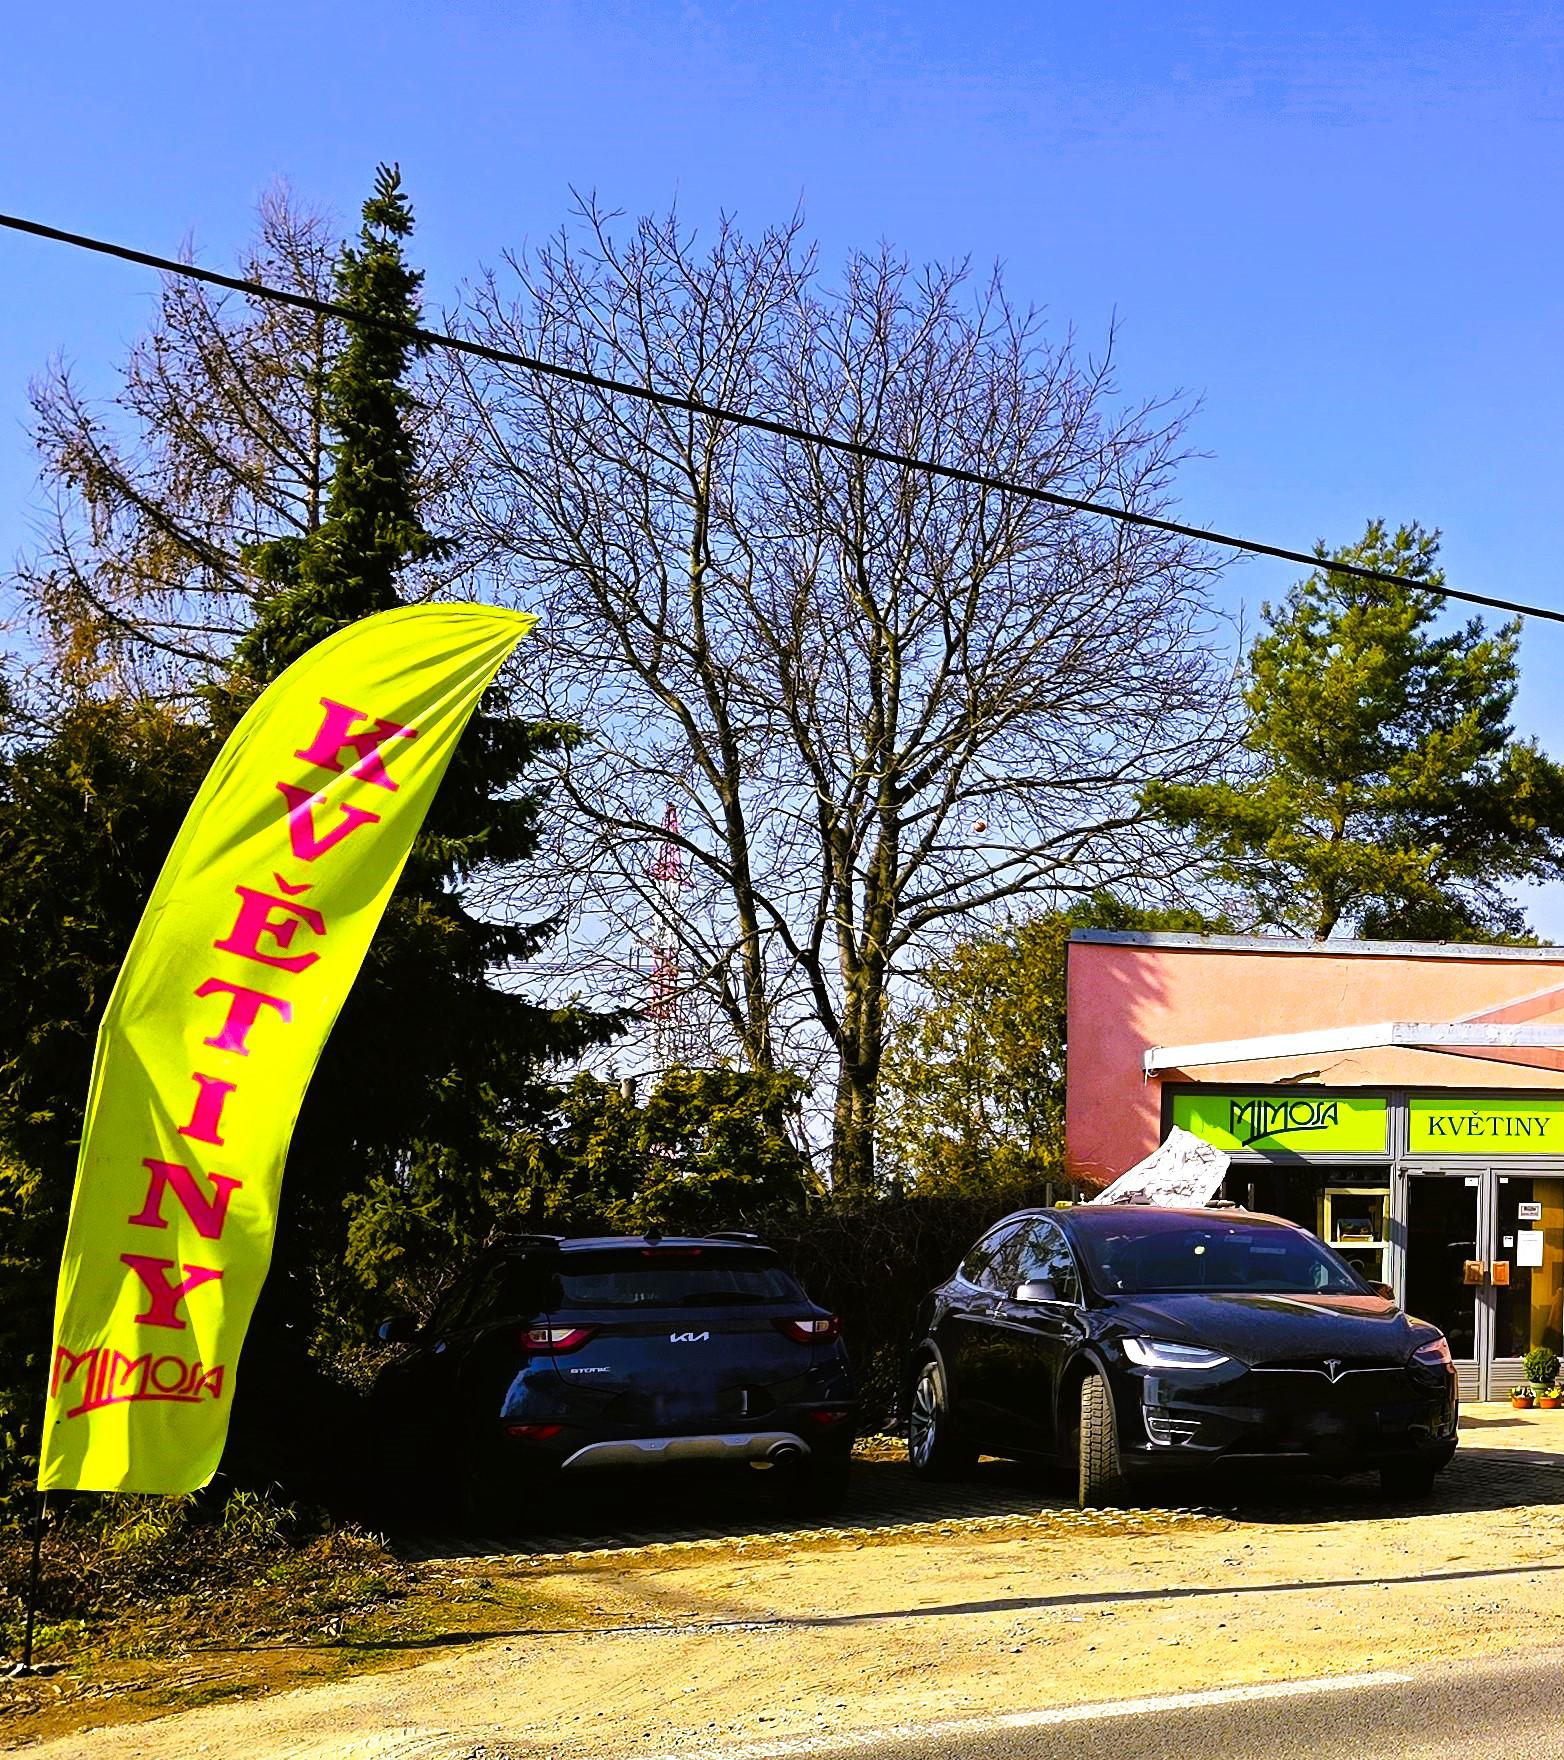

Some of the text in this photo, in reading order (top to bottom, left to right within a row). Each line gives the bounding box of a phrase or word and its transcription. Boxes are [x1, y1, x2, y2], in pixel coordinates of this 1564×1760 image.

[120, 697, 418, 1330] KVĚTINY
[1229, 1099, 1339, 1147] MIMOSA
[1427, 1110, 1551, 1137] KVĚTINY
[51, 1345, 225, 1418] MIMOSA
